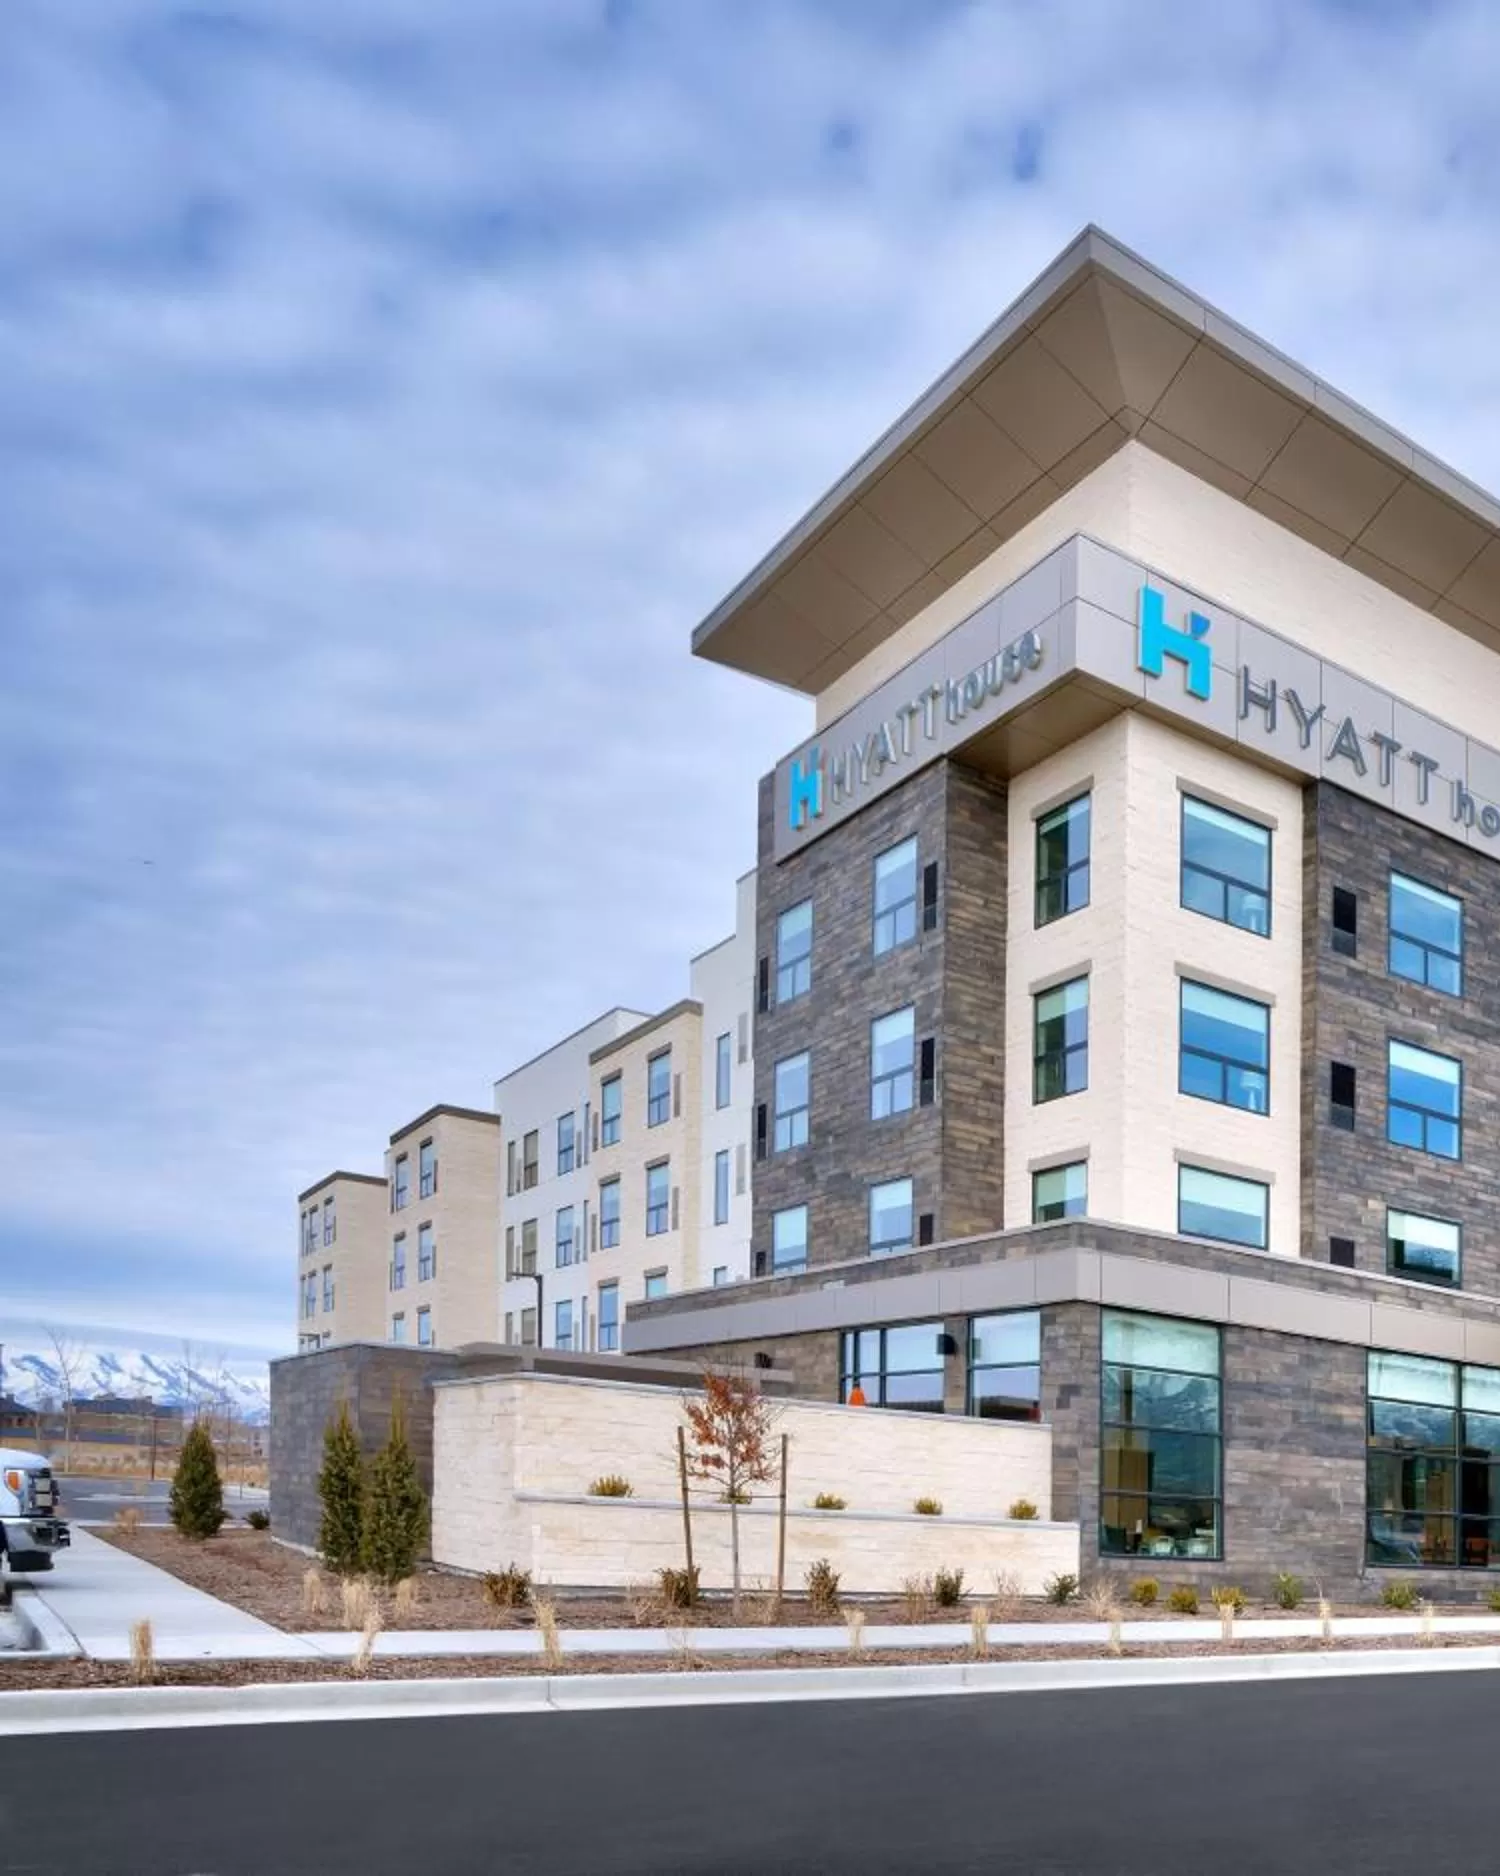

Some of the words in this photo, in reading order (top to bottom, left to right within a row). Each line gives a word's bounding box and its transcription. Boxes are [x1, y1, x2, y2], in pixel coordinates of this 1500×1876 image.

[831, 681, 944, 805] HYATT
[945, 629, 1043, 726] house
[1237, 664, 1440, 805] HYATT
